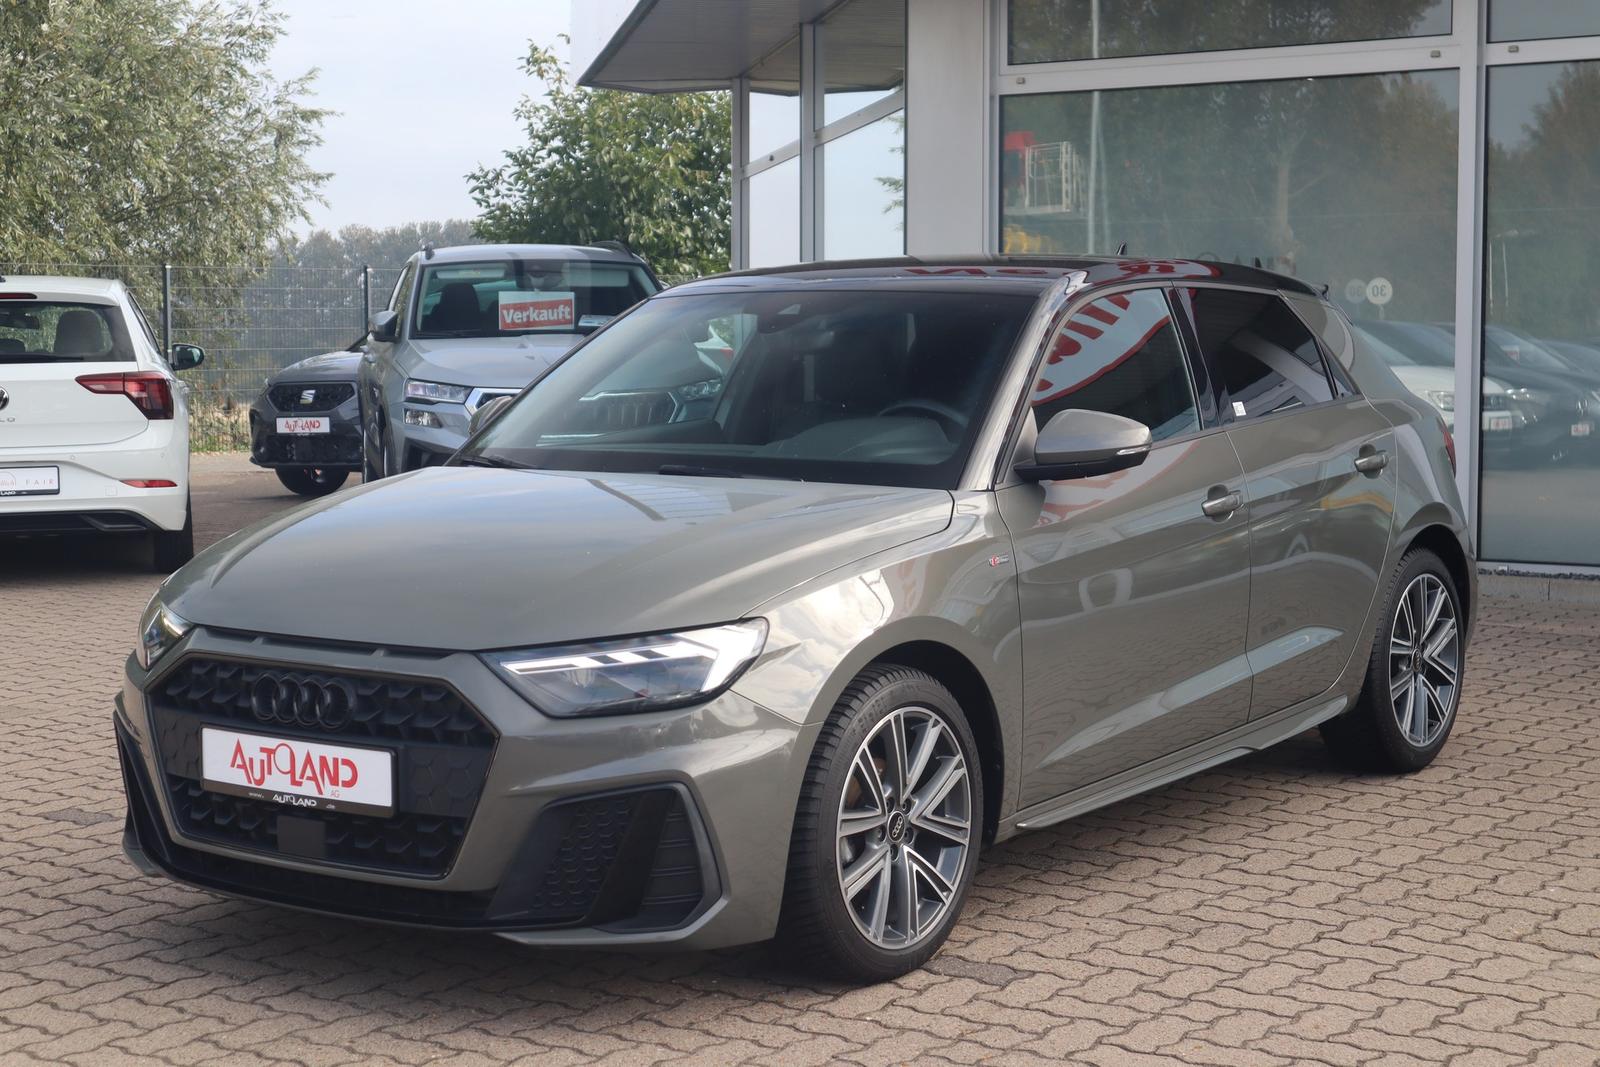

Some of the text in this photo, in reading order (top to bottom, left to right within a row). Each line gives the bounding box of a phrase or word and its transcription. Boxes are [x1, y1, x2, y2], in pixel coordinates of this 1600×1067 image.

[502, 304, 571, 324] Verkauft
[230, 737, 359, 796] AUTOLAND
[272, 793, 317, 808] AUTOLAND
